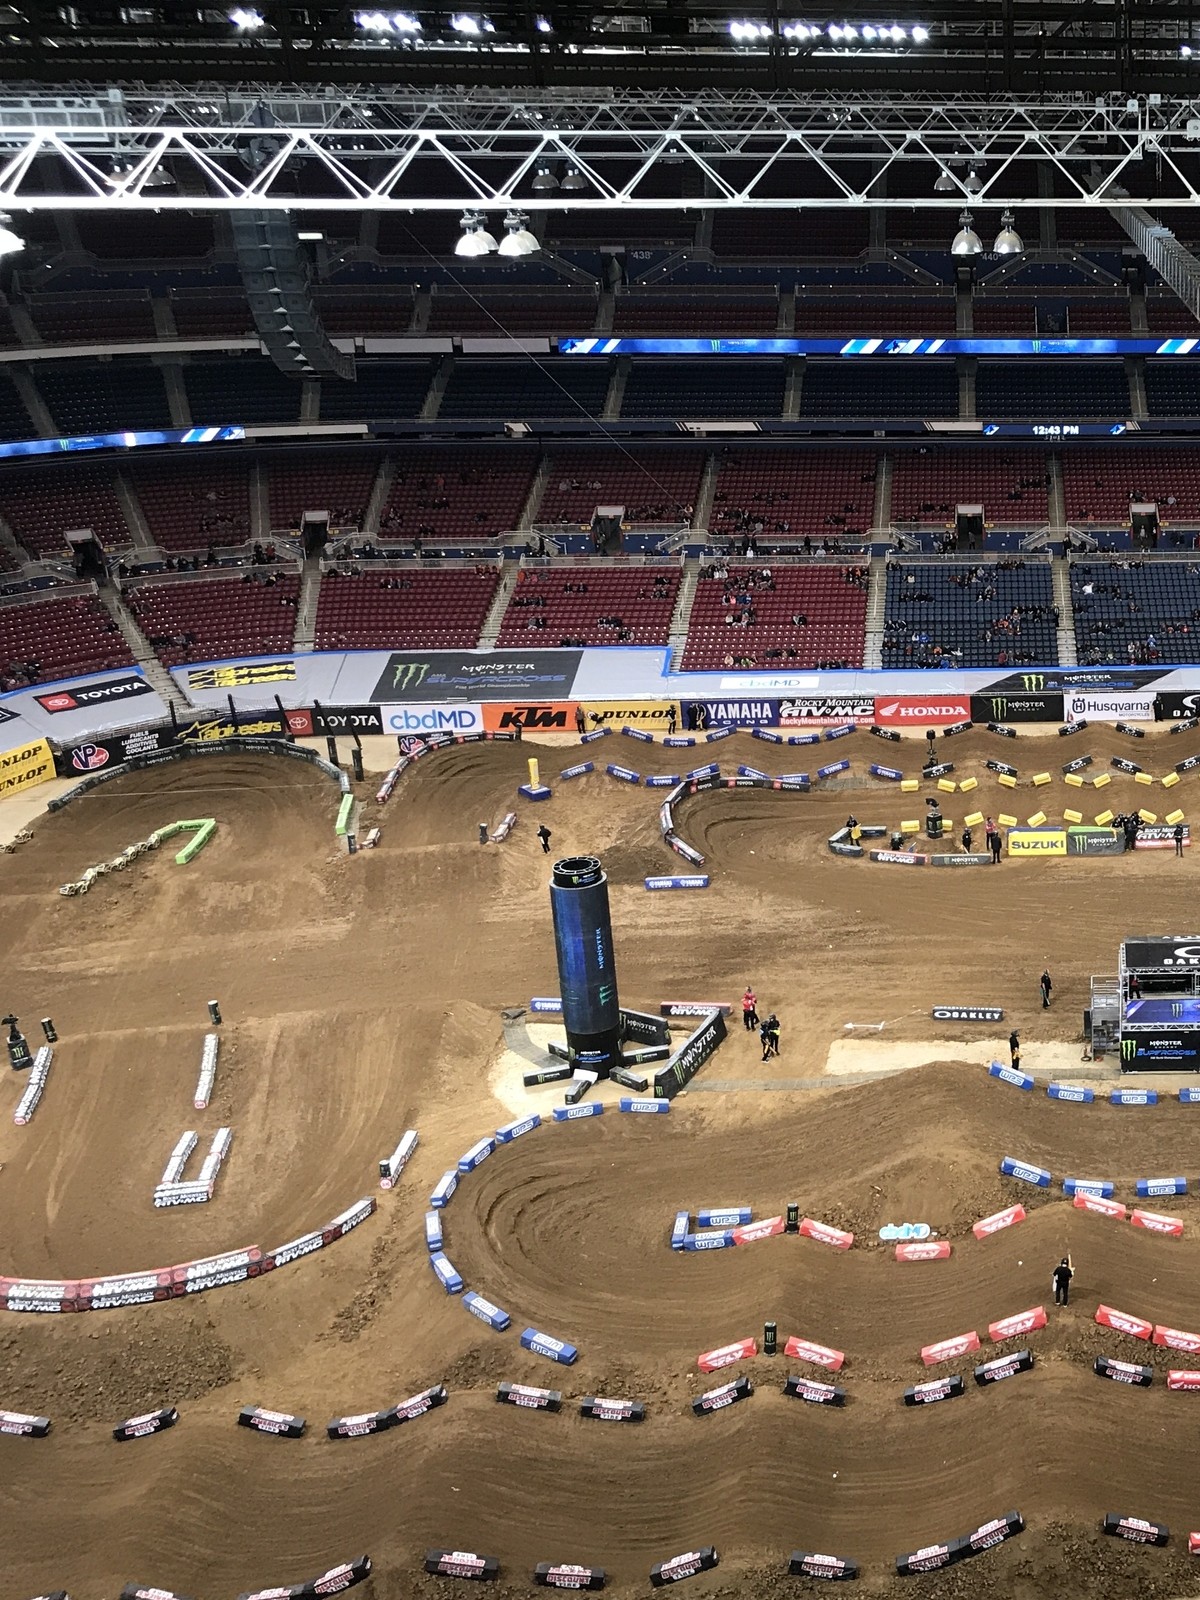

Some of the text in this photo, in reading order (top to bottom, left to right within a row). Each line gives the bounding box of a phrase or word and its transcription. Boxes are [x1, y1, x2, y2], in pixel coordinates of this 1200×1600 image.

[1032, 425, 1079, 435] 12:43 PM
[461, 663, 536, 672] MONSTER
[76, 681, 147, 701] TOYOTA
[825, 698, 874, 706] MOUNTAIN
[1007, 701, 1046, 709] MONSTER
[1088, 700, 1150, 712] Husqvarna
[707, 702, 773, 719] YAMAHA
[900, 706, 968, 716] HONDA
[388, 709, 476, 730] cbdMD
[499, 706, 568, 728] KTM
[780, 717, 876, 726] RockyMountainATVMC.com
[0, 745, 43, 769] NLOP
[0, 764, 48, 792] UNLOP
[1011, 840, 1064, 850] SUZUKI
[1087, 837, 1118, 846] MONSTER
[951, 1010, 1000, 1020] OAKLEY
[627, 1019, 657, 1033] MONSTER
[681, 1026, 717, 1069] MONSTER
[1058, 1091, 1084, 1102] WPS
[1122, 1094, 1148, 1104] WPS
[630, 1102, 660, 1112] WPS
[1148, 1186, 1176, 1196] WPS
[710, 1215, 740, 1226] WPS
[592, 1408, 632, 1418] DISCOUNT
[338, 1421, 378, 1434] DISCOUNT
[547, 1574, 592, 1584] DISCOUNT
